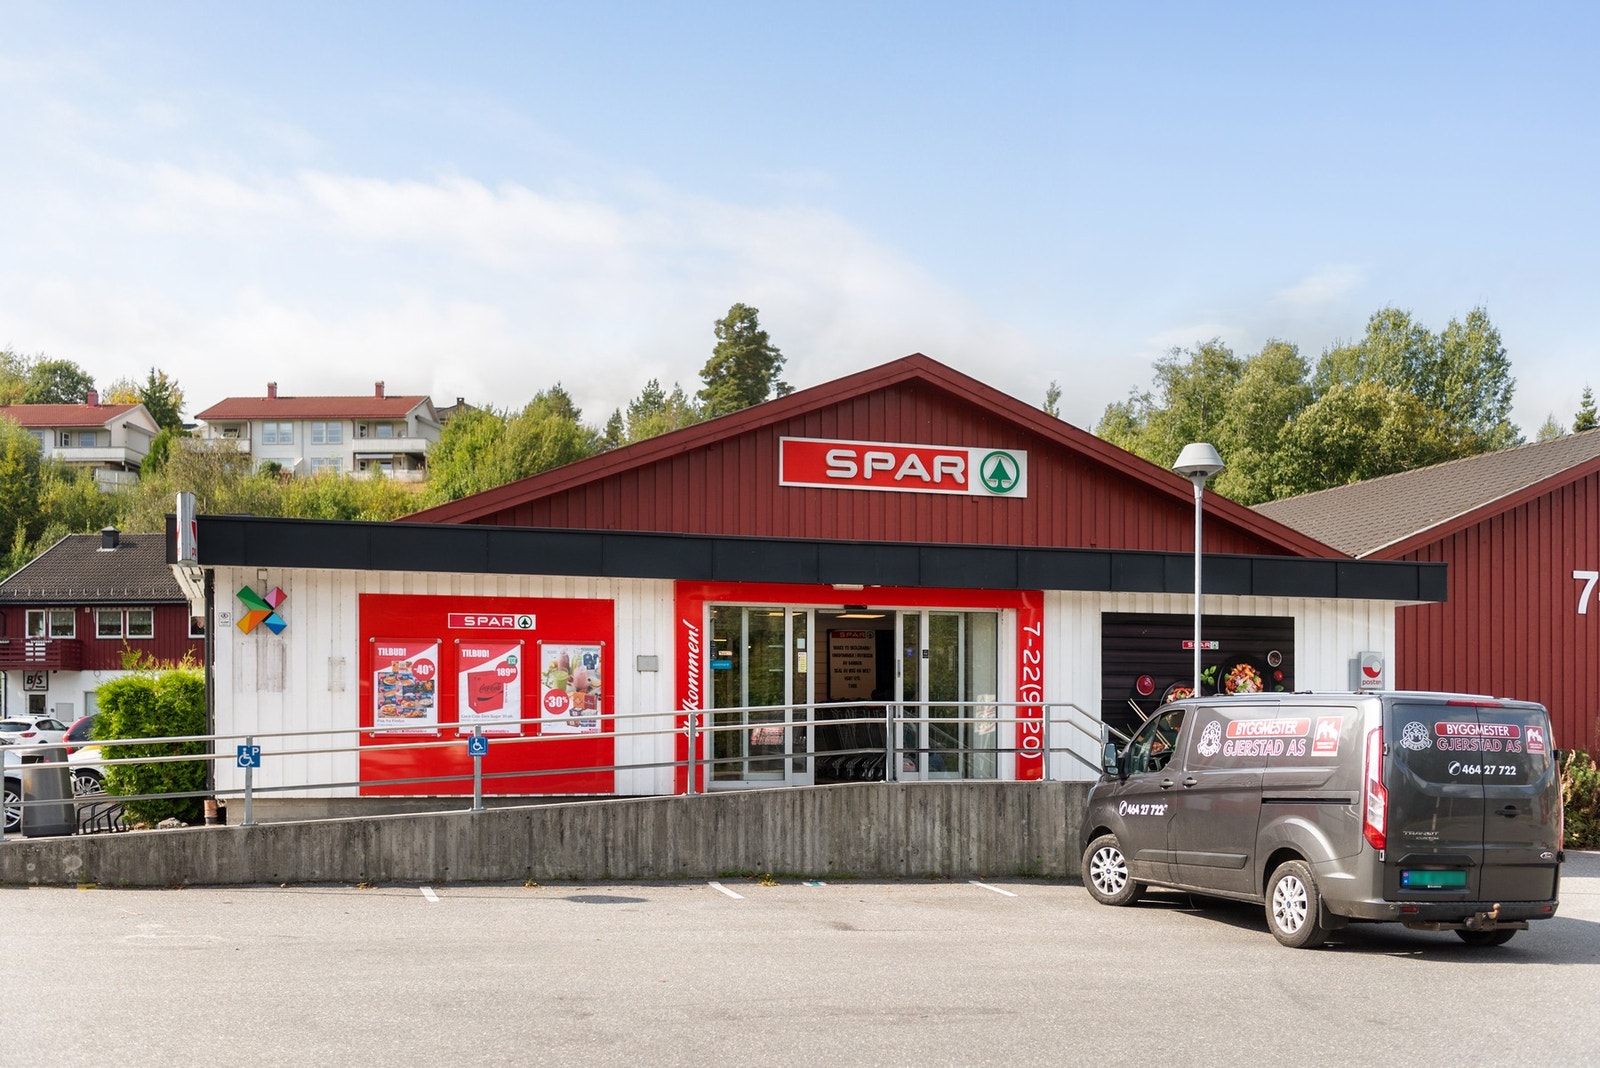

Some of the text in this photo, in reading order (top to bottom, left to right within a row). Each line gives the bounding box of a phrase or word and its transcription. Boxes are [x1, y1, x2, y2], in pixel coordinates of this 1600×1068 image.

[825, 448, 966, 484] SPAR
[464, 615, 514, 627] SPAR
[839, 631, 866, 639] SPAR
[377, 647, 407, 656] TILBUD!
[461, 649, 489, 658] TILBUD!
[1235, 720, 1298, 736] BYGGMESTER
[1446, 724, 1510, 736] BYGGMESTER
[1223, 739, 1284, 757] GJERSTAD
[1286, 738, 1307, 756] AS
[1436, 737, 1502, 752] GJERSTAD
[1505, 739, 1522, 753] AS
[251, 747, 260, 756] P
[1462, 764, 1517, 775] 464 27 722
